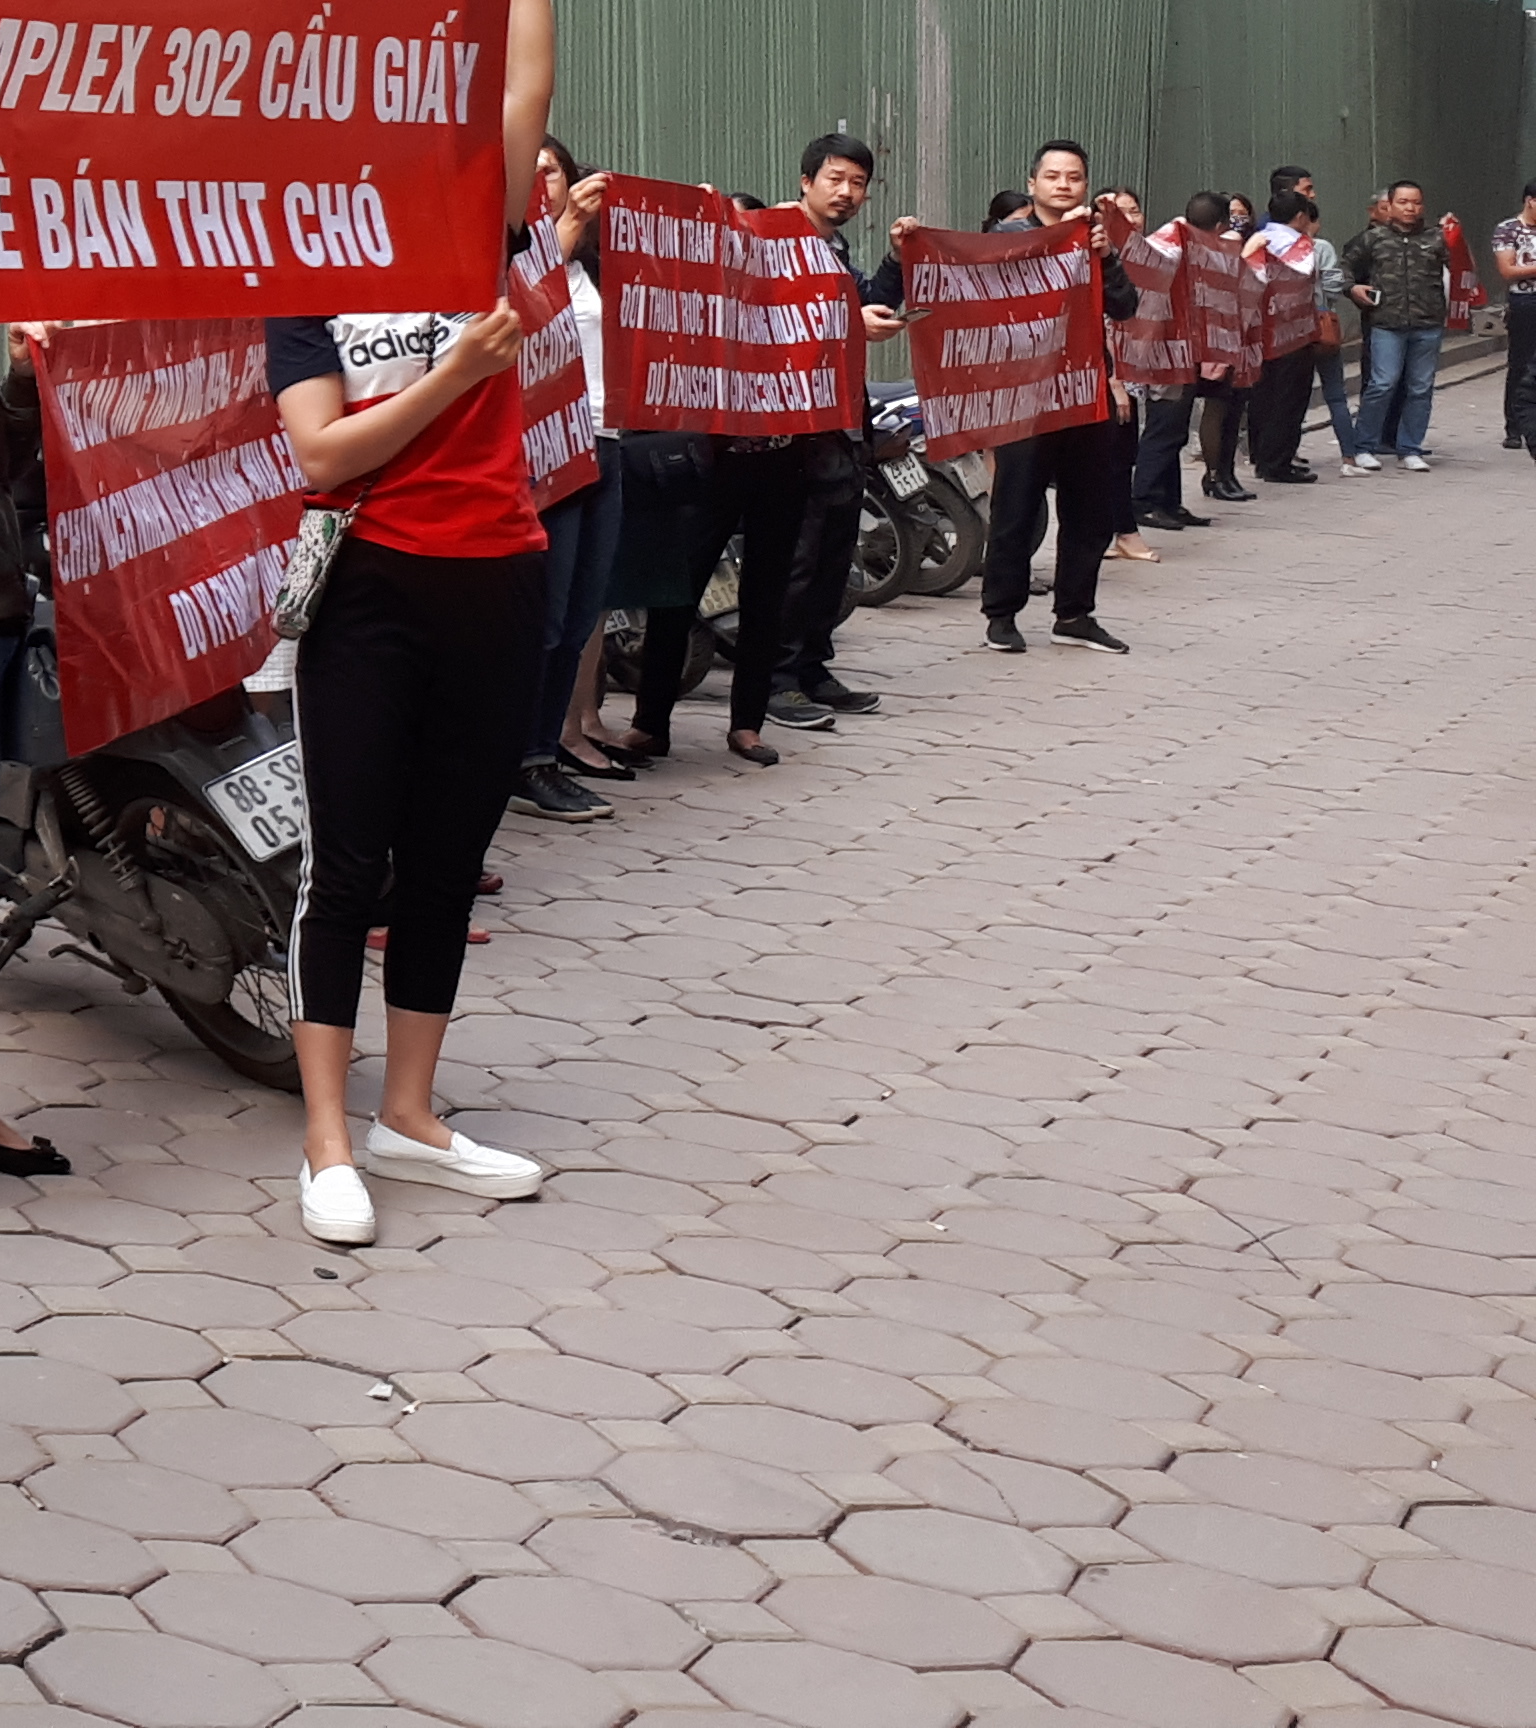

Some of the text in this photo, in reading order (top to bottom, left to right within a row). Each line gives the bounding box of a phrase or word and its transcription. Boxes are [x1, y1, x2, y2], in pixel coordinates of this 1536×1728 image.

[154, 28, 251, 117] 302
[259, 3, 358, 124] CẦU
[373, 9, 480, 124] GIẤY
[31, 158, 157, 268] BÁN
[157, 179, 275, 287] THỊT
[283, 165, 394, 268] CHÓ
